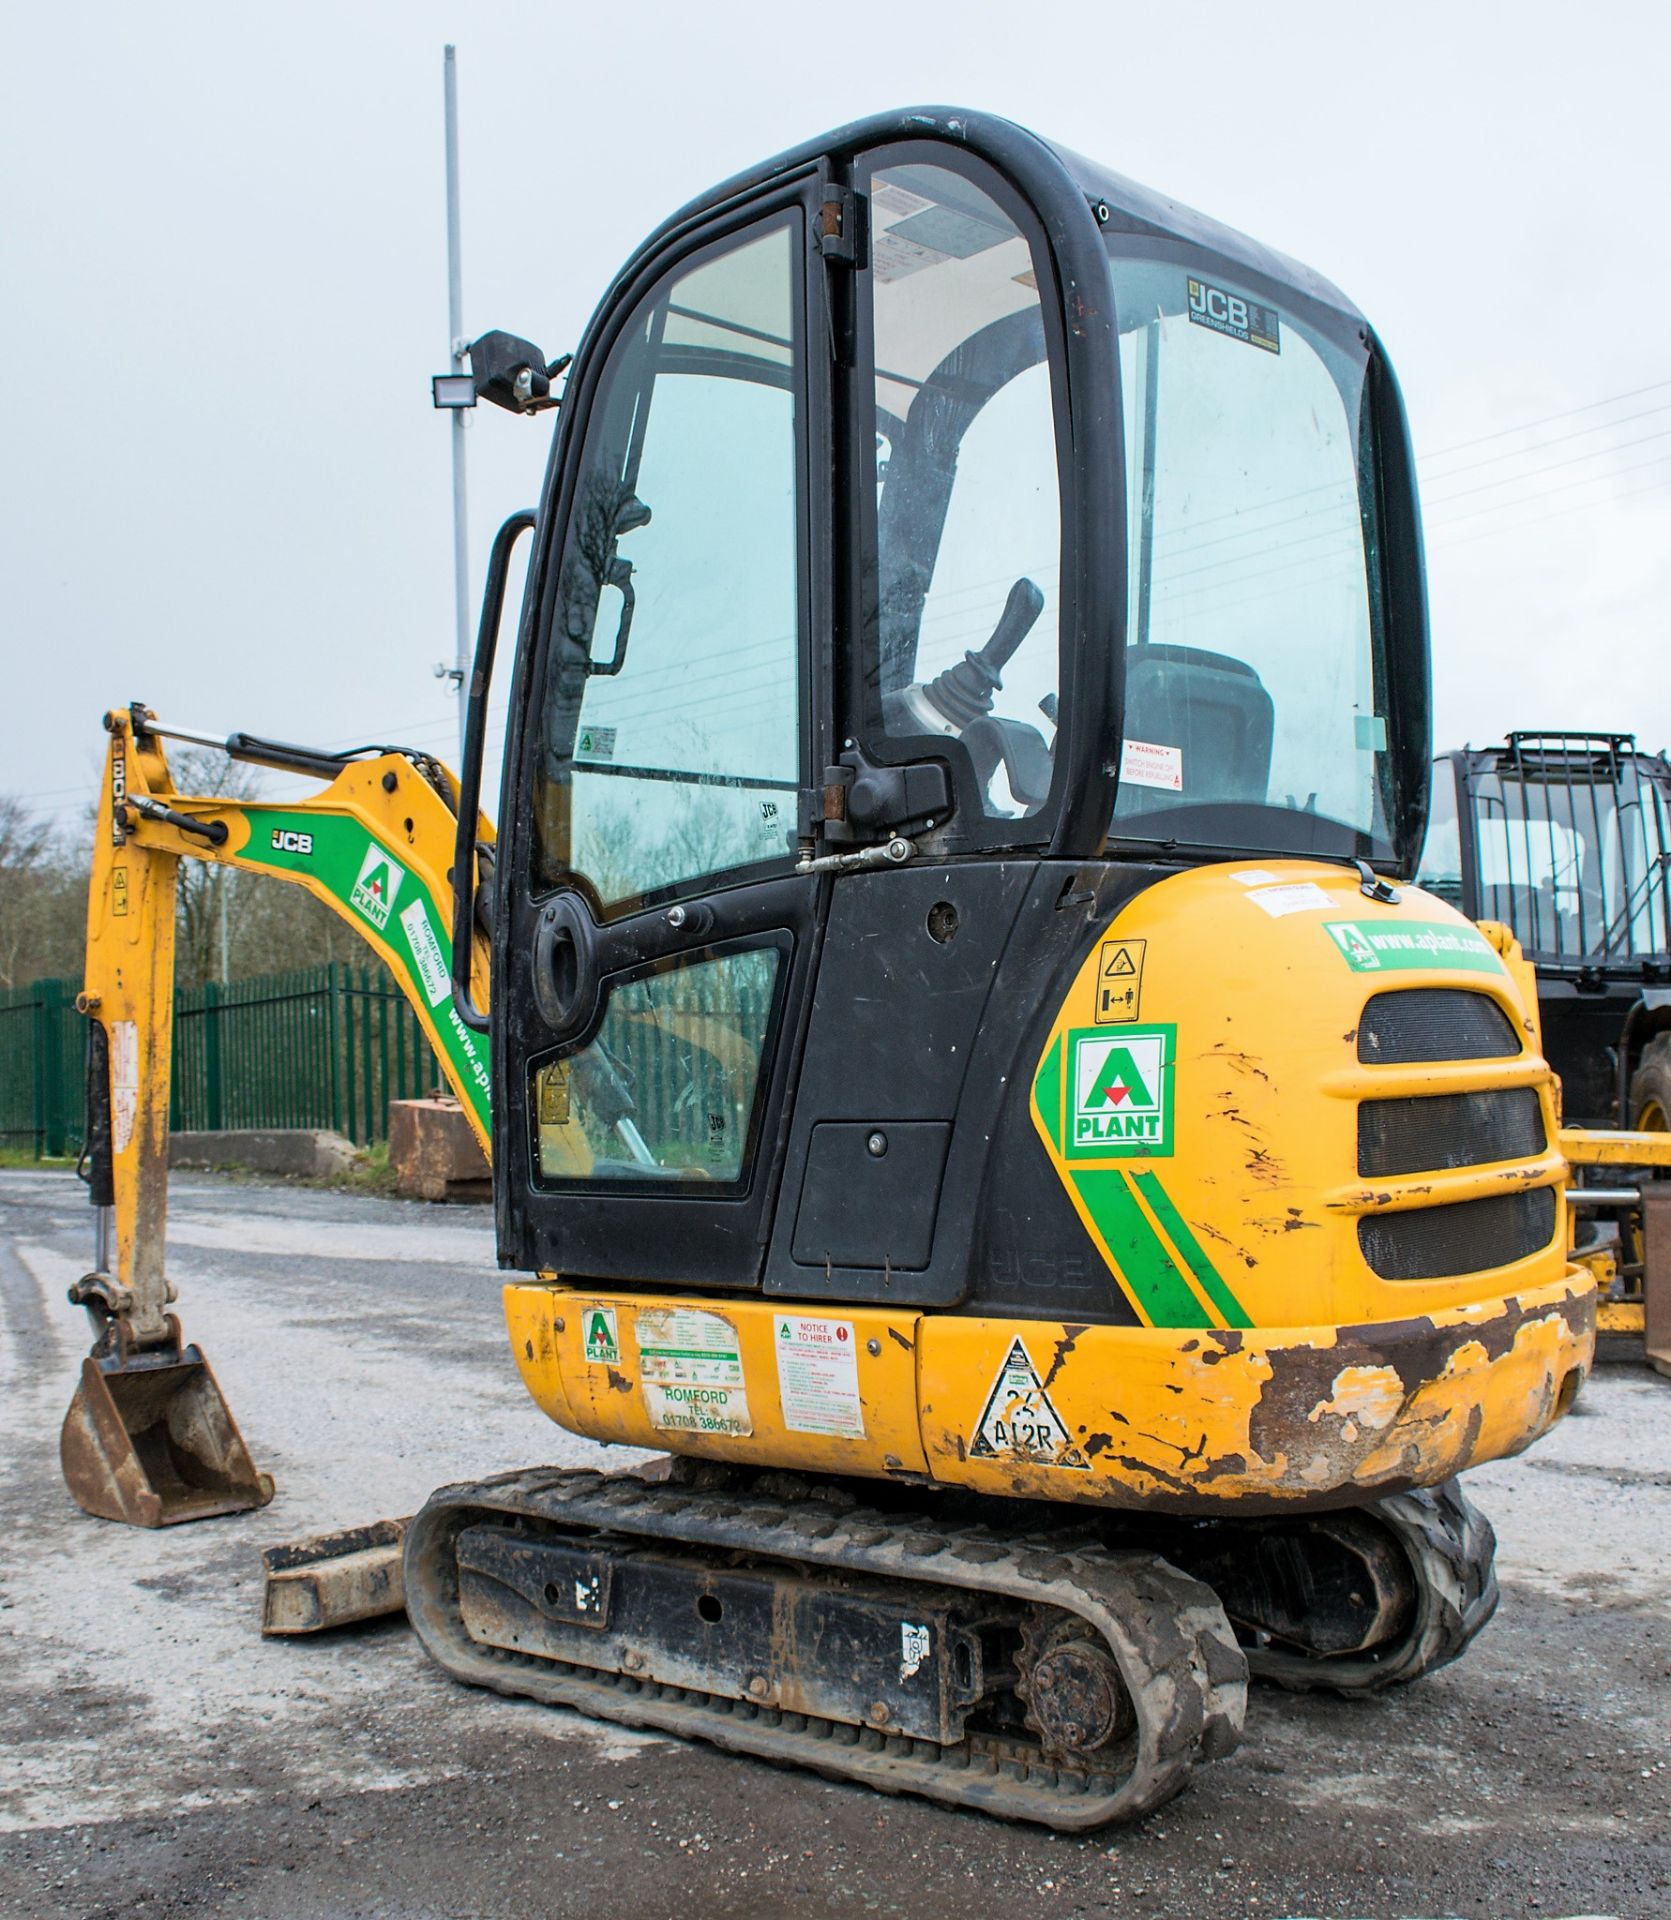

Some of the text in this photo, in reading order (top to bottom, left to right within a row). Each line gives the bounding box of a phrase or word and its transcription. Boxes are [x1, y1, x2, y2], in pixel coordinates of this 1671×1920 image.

[1190, 285, 1248, 330] JCB
[1136, 745, 1164, 756] WARNING
[272, 830, 312, 853] JCB
[352, 887, 388, 924] PLANT
[421, 918, 447, 979] ROMFORD
[1367, 929, 1493, 956] www.aplant.com
[1084, 1047, 1155, 1109] A
[1077, 1115, 1160, 1139] PLANT
[588, 1312, 615, 1347] A
[798, 1332, 833, 1344] TO HIRER
[800, 1323, 828, 1333] NOTICE
[586, 1347, 618, 1360] PLANT
[665, 1388, 728, 1405] ROMFORD
[662, 1414, 742, 1433] 01708 386672
